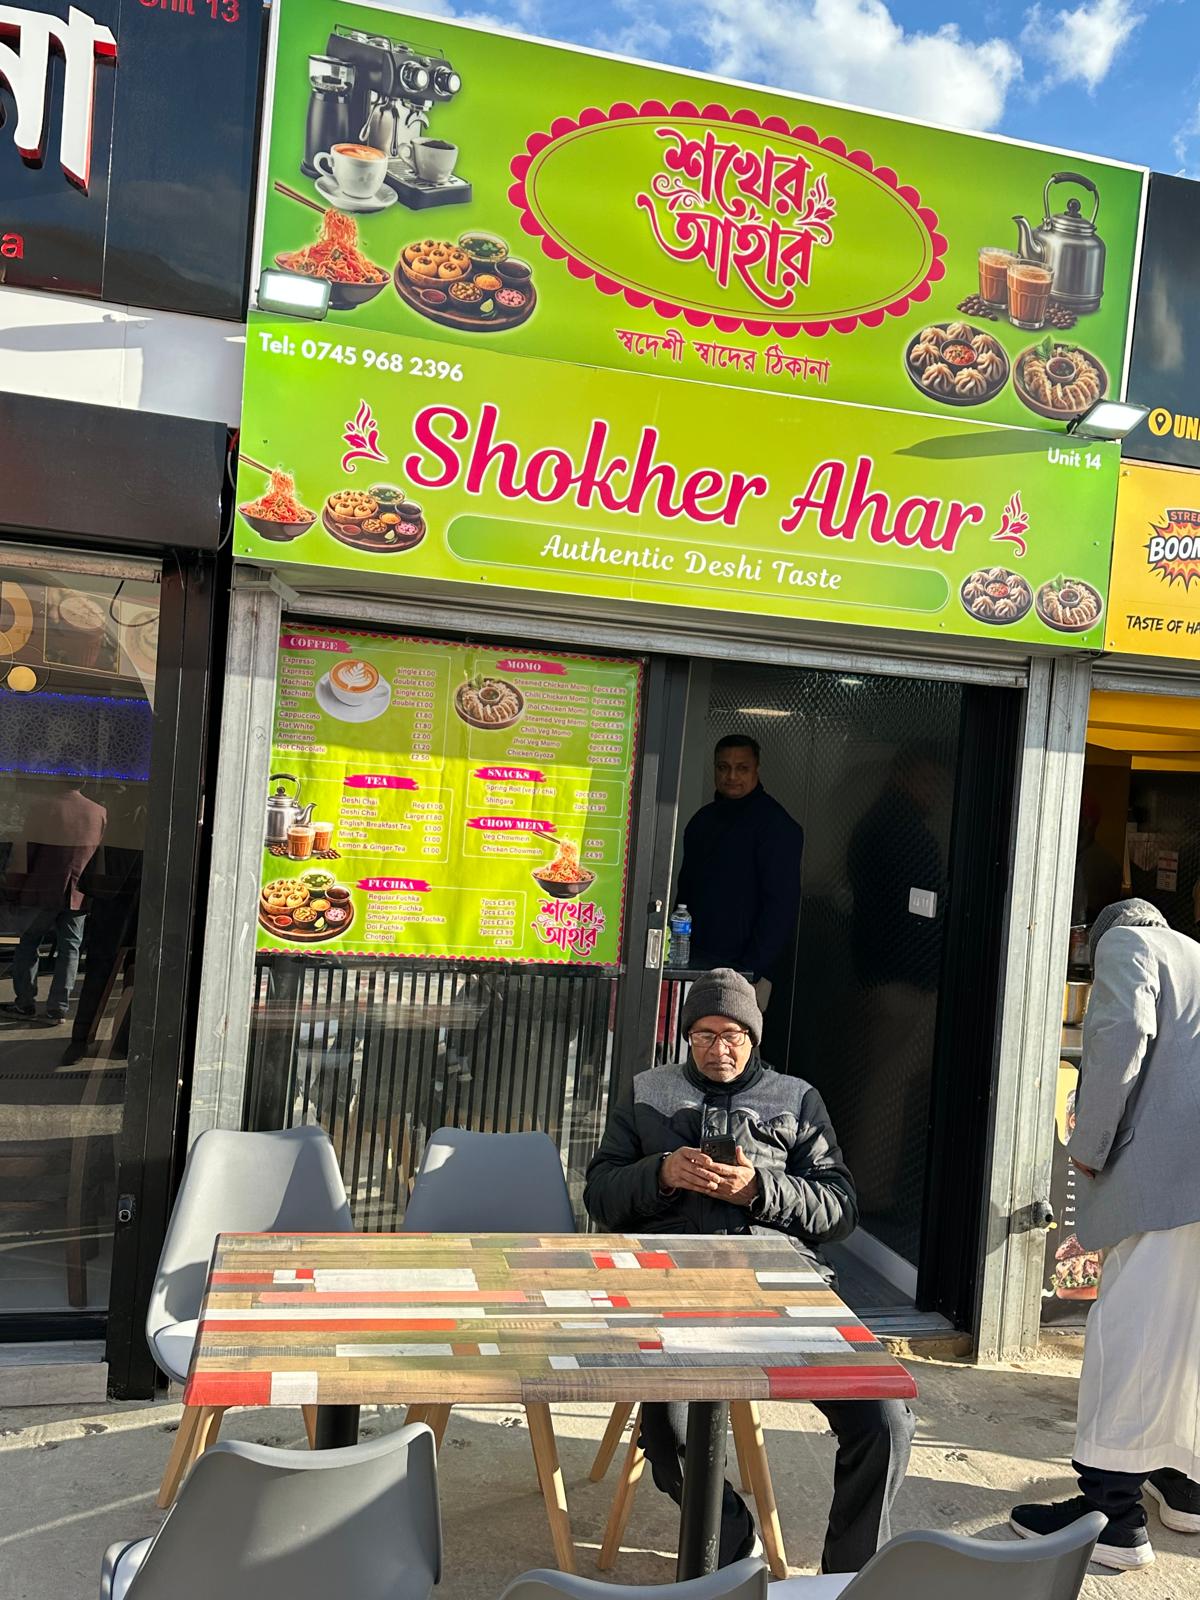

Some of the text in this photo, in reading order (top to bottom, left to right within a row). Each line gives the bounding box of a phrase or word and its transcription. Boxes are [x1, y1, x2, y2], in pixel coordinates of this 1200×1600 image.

[636, 194, 818, 309] আহার
[259, 332, 464, 382] Tel: 0745 968 2396
[616, 328, 831, 384] স্বদেশী স্বাদের ঠিকানা
[1047, 447, 1102, 471] Unit 14
[404, 403, 985, 555] Shokher Ahar
[540, 534, 842, 591] Authentic Deshi Taste
[1126, 615, 1164, 632] TASTE
[1167, 619, 1184, 634] OF
[290, 637, 339, 651] COFFEE
[507, 660, 542, 672] MOMO
[543, 681, 569, 689] Chicken
[543, 693, 568, 701] Chicken
[541, 704, 567, 712] Chicken
[279, 711, 320, 720] Cappuccino
[277, 732, 315, 741] Americano
[538, 728, 550, 736] Veg
[507, 749, 534, 757] Chicken
[535, 751, 554, 760] Gyoza
[487, 769, 530, 780] SNACKS
[365, 776, 388, 786] TEA
[486, 784, 507, 793] Spring
[342, 796, 360, 804] Deshi
[486, 797, 513, 806] Shingara
[341, 808, 359, 816] Deshi
[405, 813, 424, 821] Large
[340, 819, 364, 829] English
[366, 821, 399, 830] Breakfast
[480, 819, 545, 831] CHOW MEIN
[339, 830, 354, 838] Mint
[483, 833, 495, 841] Veg
[497, 834, 530, 842] Chowmein
[370, 843, 393, 853] Ginger
[482, 845, 508, 854] Chicken
[510, 847, 543, 856] Chowmein
[368, 879, 415, 890] FUCHKA
[368, 894, 394, 902] Regular
[481, 899, 496, 907] 7pcs
[368, 904, 397, 913] Jalapeno
[481, 909, 496, 917] 7pcs
[367, 914, 390, 922] Smoky
[390, 915, 420, 924] Jalapeno
[365, 933, 395, 942] Chotpoti
